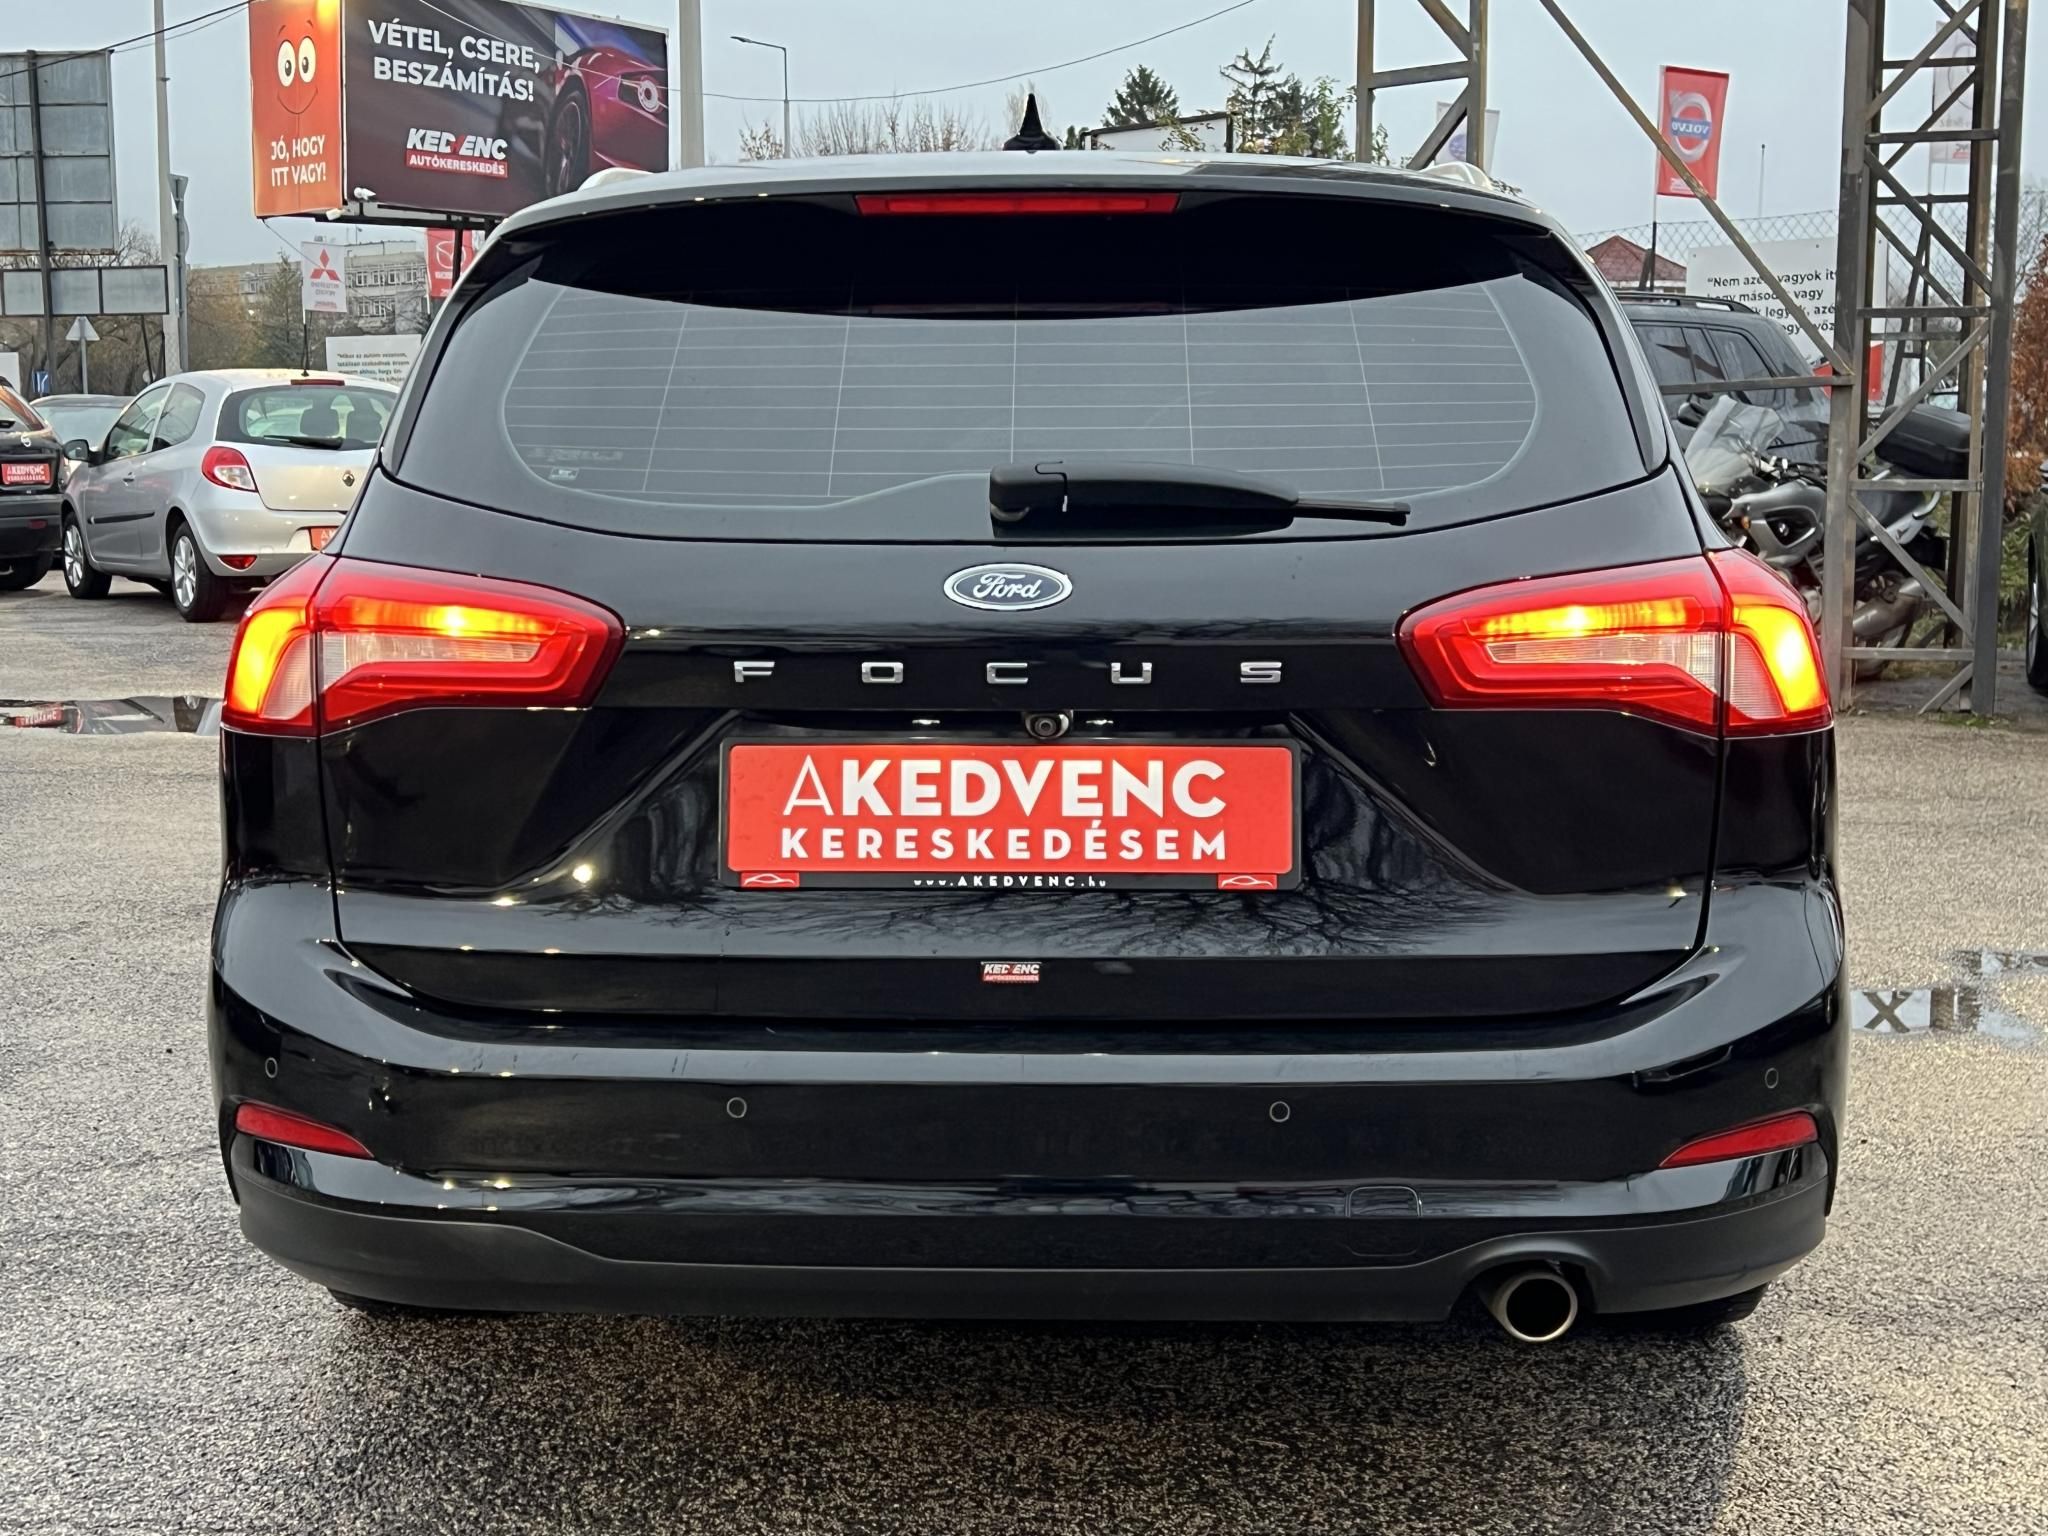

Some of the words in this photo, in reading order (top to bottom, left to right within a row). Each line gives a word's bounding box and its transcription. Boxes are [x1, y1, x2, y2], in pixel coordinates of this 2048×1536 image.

[367, 17, 454, 60] VÉTEL,
[460, 35, 541, 74] CSERE,
[374, 56, 535, 102] BESZÁMÍTÁS!
[270, 135, 290, 163] JÓ,
[292, 134, 326, 158] HOGY
[271, 166, 289, 187] ITT
[291, 161, 327, 185] VAGY!
[409, 153, 506, 176] AUTÓKERESKEDÉS
[1777, 269, 1822, 285] vagyok
[1793, 289, 1823, 301] vagy
[972, 572, 1042, 599] Ford
[733, 660, 1282, 685] FOCUS
[781, 819, 1227, 861] KERESKEDÉSEM
[913, 875, 1107, 888] www.AKEDVENC.hu
